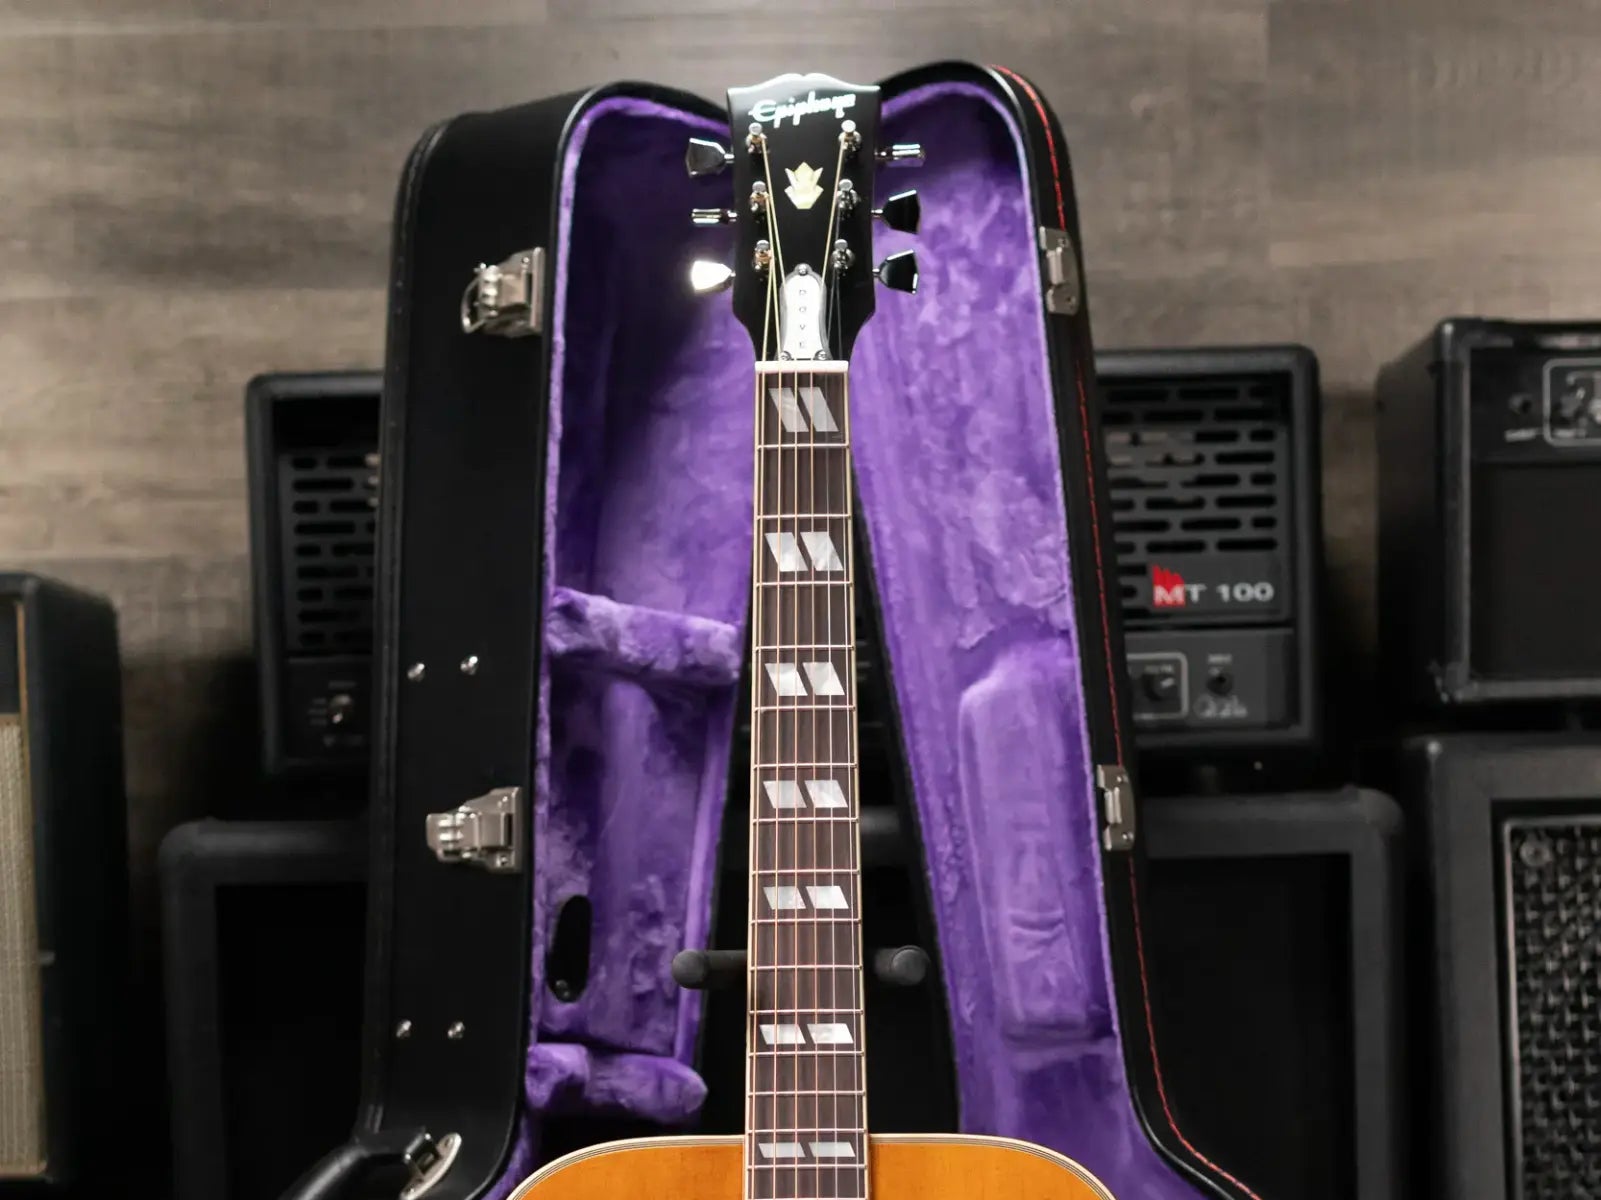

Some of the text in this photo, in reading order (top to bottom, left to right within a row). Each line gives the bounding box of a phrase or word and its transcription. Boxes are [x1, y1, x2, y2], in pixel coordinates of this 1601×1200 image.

[748, 91, 856, 128] Epiphone
[798, 289, 807, 349] DOVE
[1153, 582, 1274, 604] MT 100
